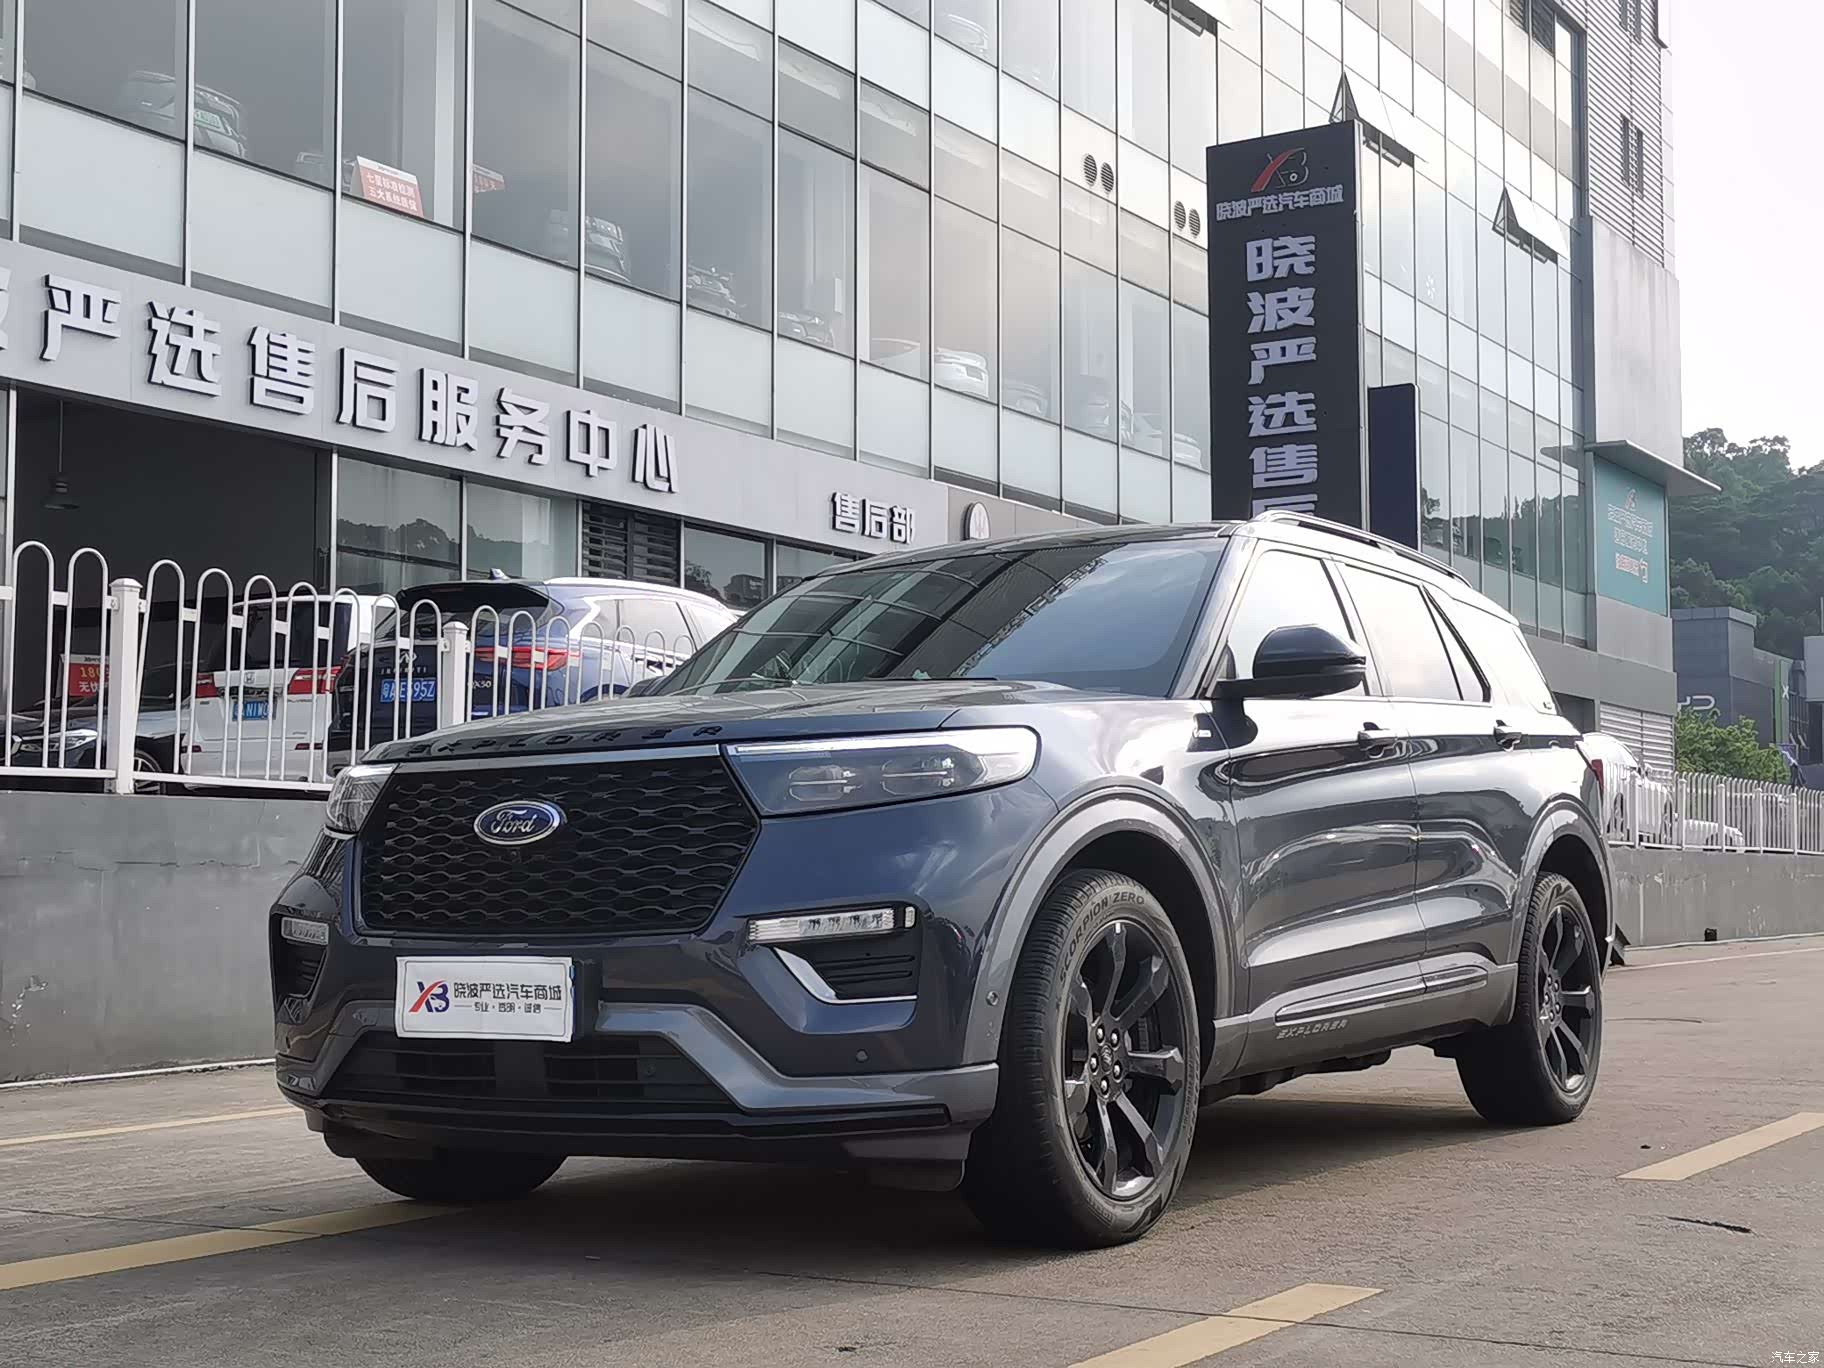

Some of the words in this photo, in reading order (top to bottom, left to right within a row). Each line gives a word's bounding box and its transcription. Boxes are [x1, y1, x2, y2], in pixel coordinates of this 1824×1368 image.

[1216, 184, 1344, 221] 晓波严选汽车商城
[832, 491, 916, 545] 售后部
[468, 680, 492, 689] X50
[490, 809, 538, 834] Ford
[1060, 895, 1109, 982] SCORPION
[1112, 891, 1146, 906] ZERO
[453, 982, 562, 1001] 晓波严选汽车商城
[1276, 1019, 1348, 1040] EXPLORER
